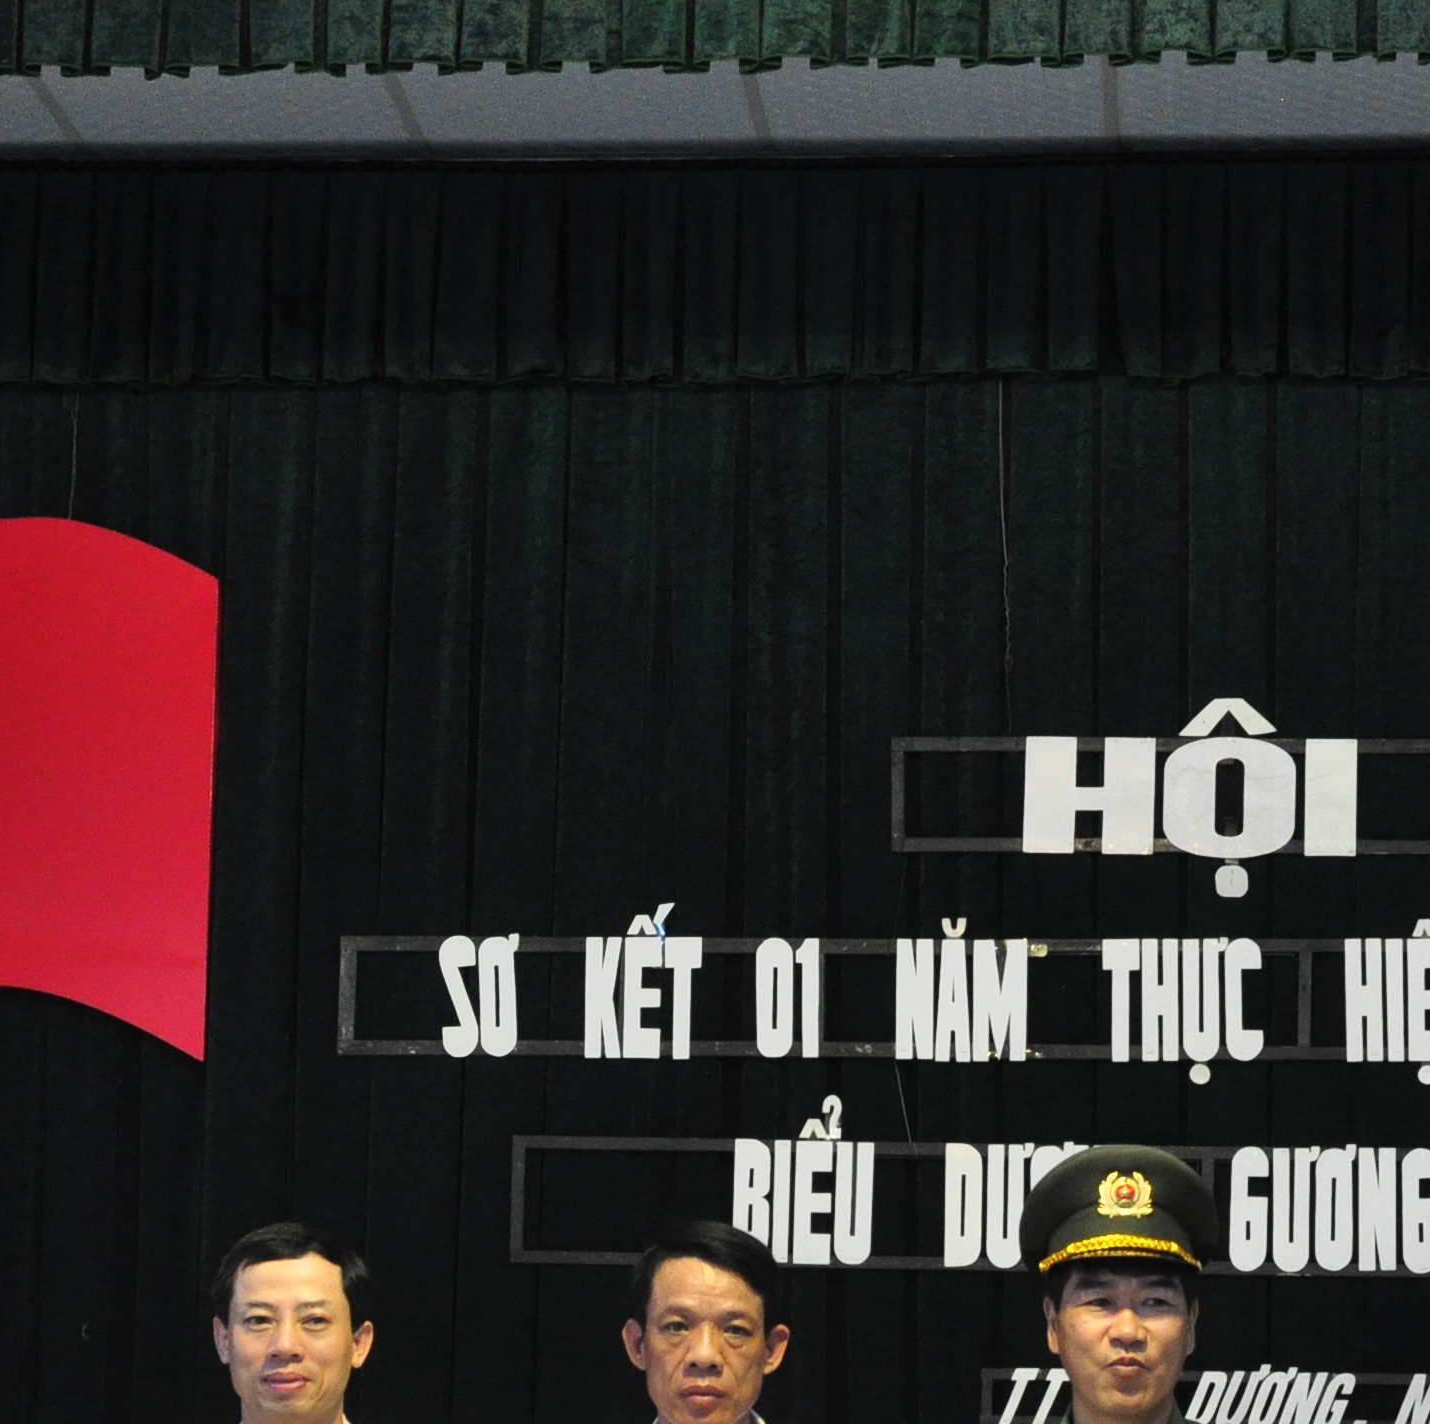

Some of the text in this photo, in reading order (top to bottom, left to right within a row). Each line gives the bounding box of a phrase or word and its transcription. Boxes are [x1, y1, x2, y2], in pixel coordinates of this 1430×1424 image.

[1023, 698, 1357, 897] HỘI
[439, 933, 519, 1058] SƠ
[584, 903, 703, 1060] KẾT
[756, 937, 821, 1058] 01
[895, 918, 1028, 1062] NĂM
[1102, 937, 1264, 1085] THỰC
[733, 1095, 875, 1266] BIỂU
